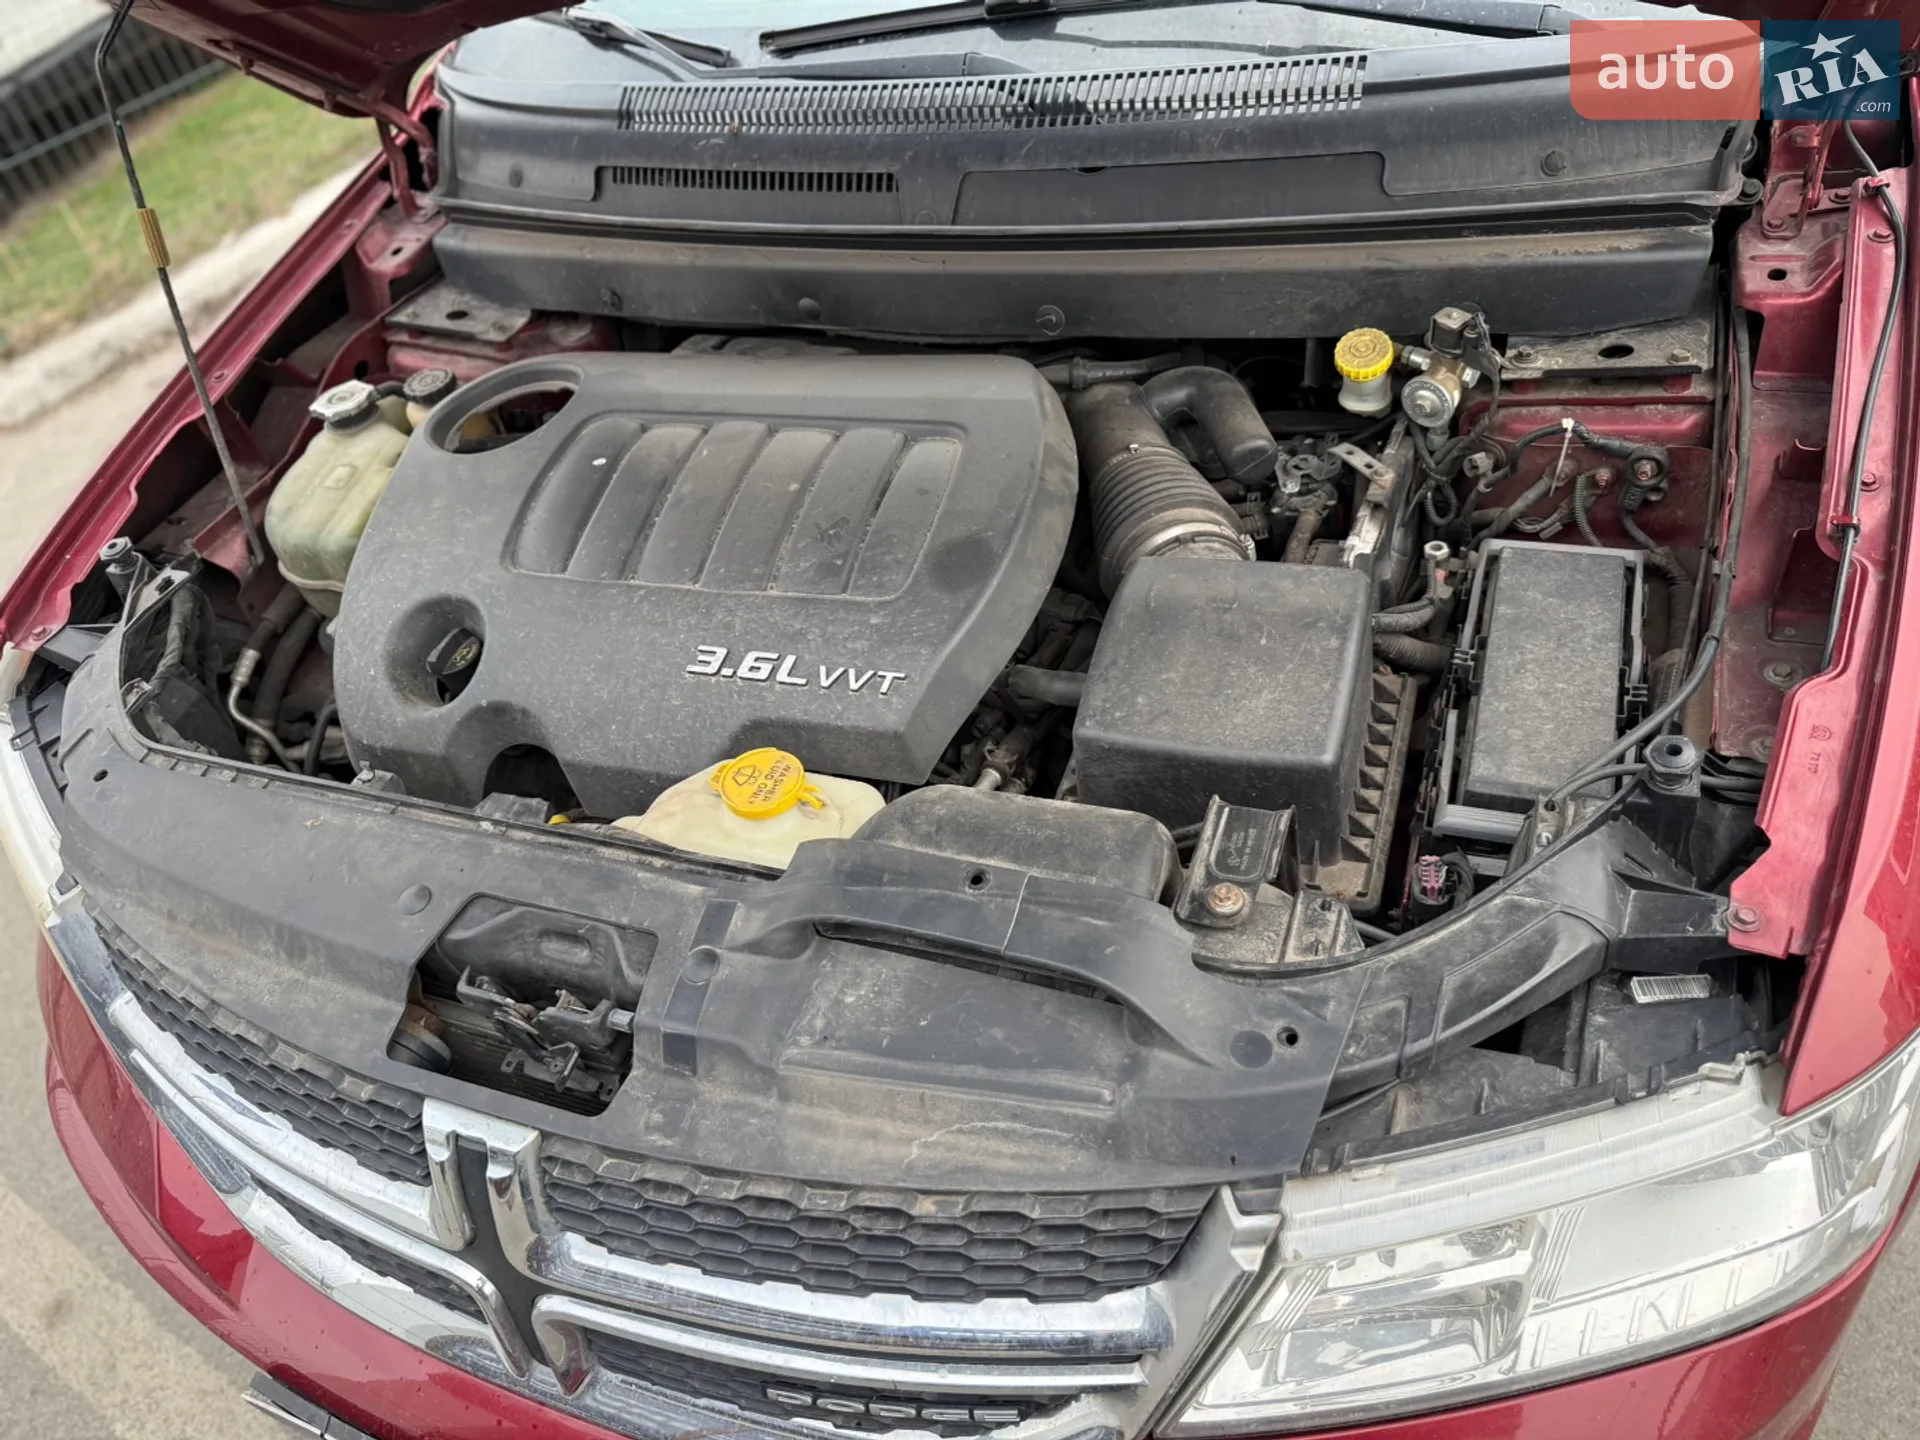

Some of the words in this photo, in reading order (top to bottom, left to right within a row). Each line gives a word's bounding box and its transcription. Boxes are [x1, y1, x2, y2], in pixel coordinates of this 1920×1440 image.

[686, 645, 808, 685] 3.6L
[819, 665, 907, 695] VVT
[761, 765, 791, 802] WASHER
[766, 1387, 1021, 1422] DODGE
